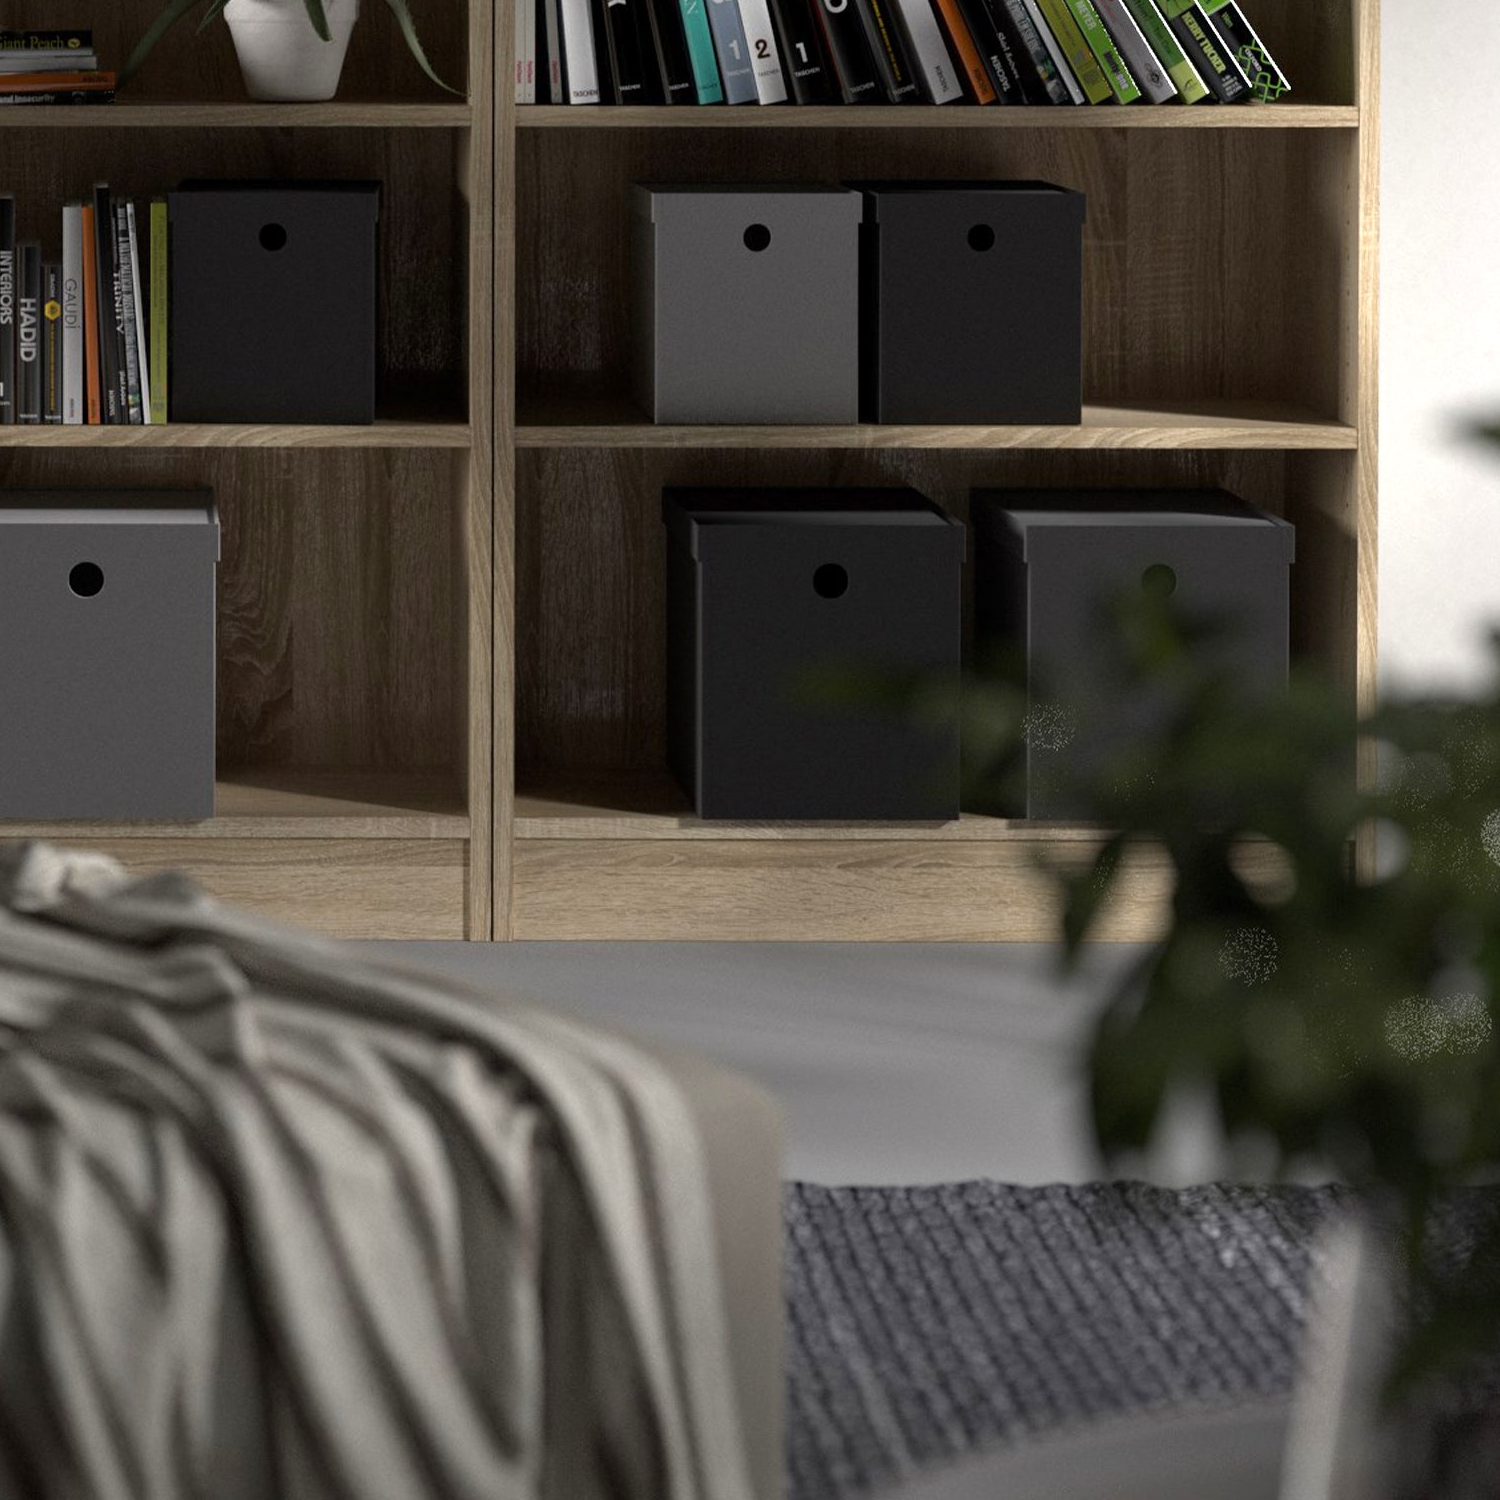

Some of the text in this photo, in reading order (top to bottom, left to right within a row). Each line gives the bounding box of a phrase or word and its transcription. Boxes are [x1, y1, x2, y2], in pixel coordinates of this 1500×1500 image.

[1076, 1, 1097, 29] MEYER
[29, 35, 64, 49] Peach
[727, 39, 742, 61] 1
[754, 38, 771, 60] 2
[795, 42, 809, 64] 1
[1182, 13, 1225, 73] KERRY TUCKER
[0, 250, 12, 325] INTERIORS
[64, 279, 80, 329] GAUDÍ
[113, 271, 124, 334] TRINITY
[20, 298, 36, 362] HADID
